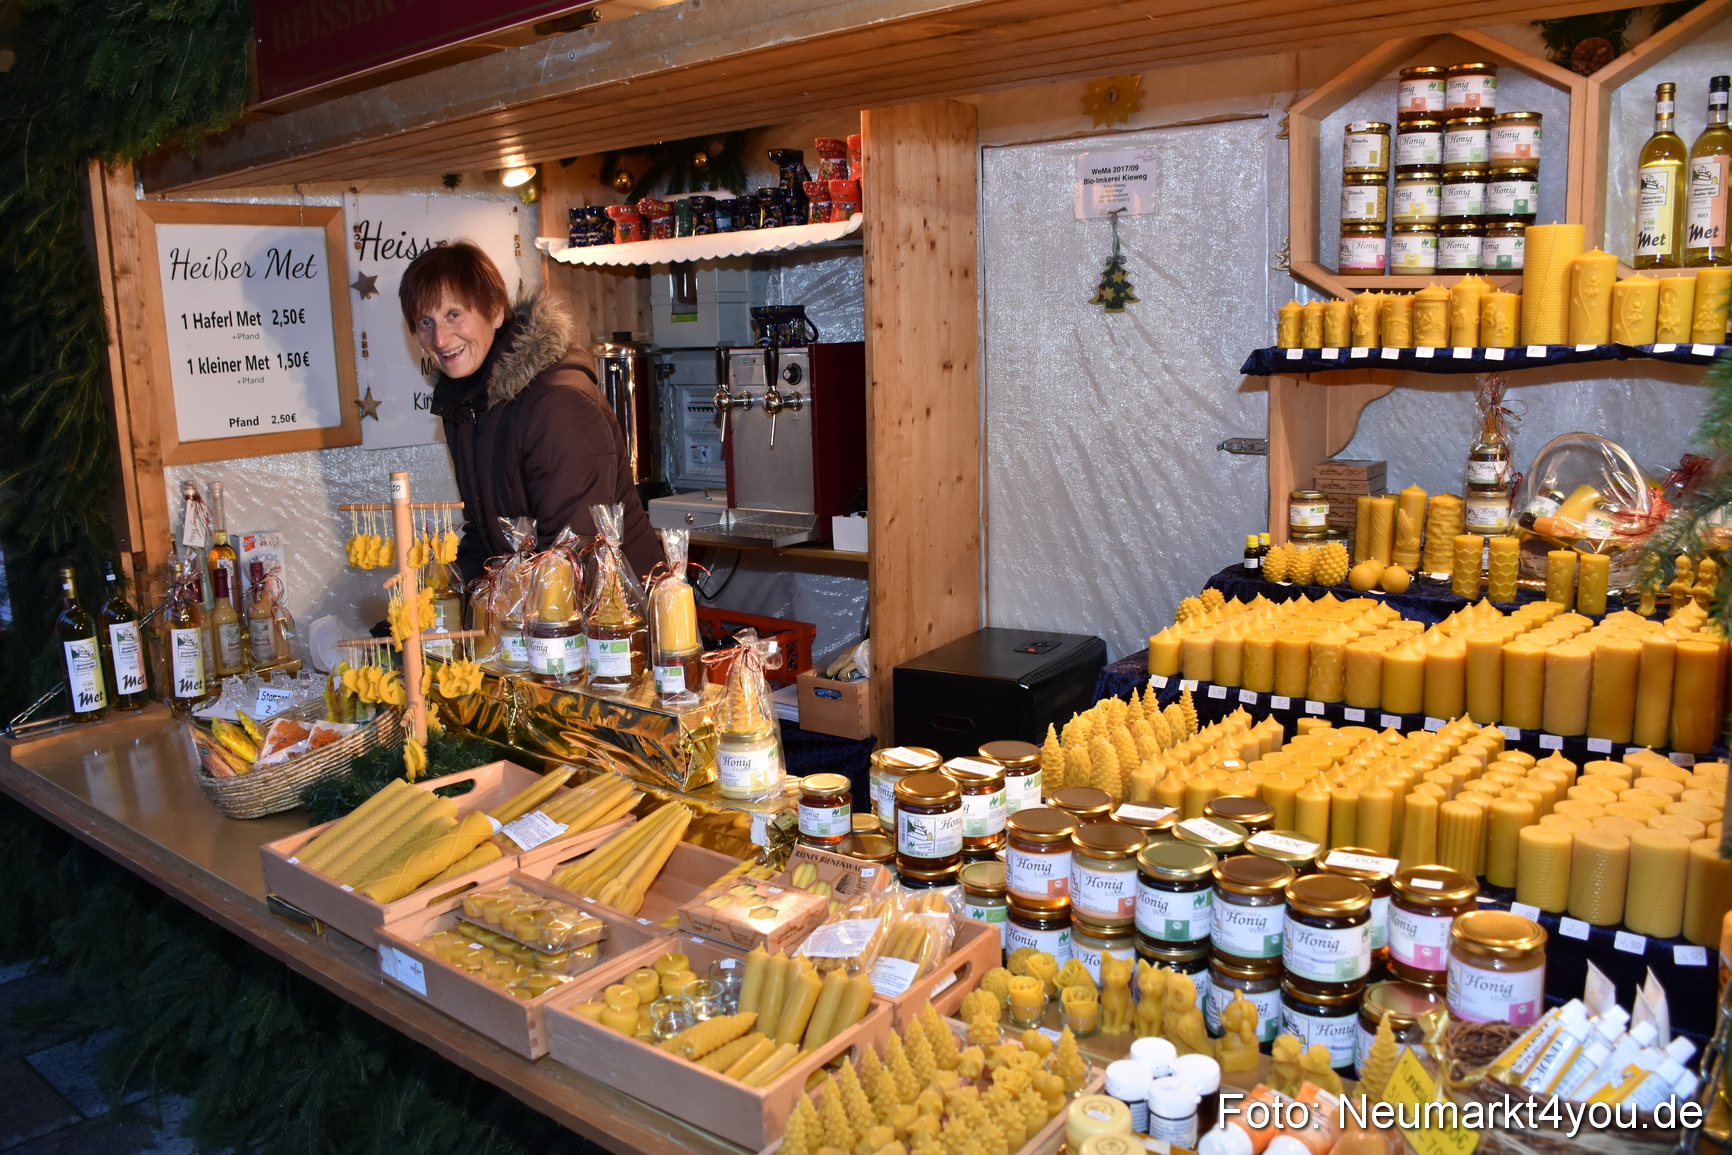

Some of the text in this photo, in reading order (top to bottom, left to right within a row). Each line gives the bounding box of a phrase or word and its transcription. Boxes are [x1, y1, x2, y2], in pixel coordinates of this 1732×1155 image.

[1402, 137, 1426, 146] Honig
[1450, 135, 1473, 144] Honig
[1496, 131, 1520, 140] Honig
[1092, 165, 1139, 175] WeMa 2017/09
[1084, 176, 1120, 185] Bio-Imkerei
[1448, 188, 1470, 197] Honig
[1492, 186, 1517, 195] Honig
[1637, 231, 1666, 250] Met
[1689, 223, 1719, 243] Met
[1356, 242, 1378, 252] Honig
[1446, 242, 1469, 250] Honig
[170, 247, 318, 282] Heißer Met
[181, 308, 306, 330] 1 Haferl Met 2,50€
[231, 331, 260, 341] +Pfand
[187, 351, 310, 375] 1 kleiner Met 1,50€
[236, 375, 265, 385] +Pfand
[229, 412, 297, 428] Pfand 2,50€
[122, 674, 145, 690] Met
[179, 678, 202, 693] Met
[78, 690, 103, 708] Met
[723, 756, 751, 769] Honig
[1267, 836, 1306, 848] 7.00€
[795, 850, 864, 872] REINES BIENENWAC
[1016, 858, 1052, 874] Honig
[1085, 875, 1124, 893] Honig
[1138, 890, 1168, 913] Honig
[1227, 911, 1268, 929] Honig
[1390, 914, 1419, 936] Honig
[1009, 928, 1038, 948] Honig
[1298, 932, 1340, 952] Honig
[1466, 974, 1514, 997] Honig
[1315, 1022, 1356, 1038] Honig
